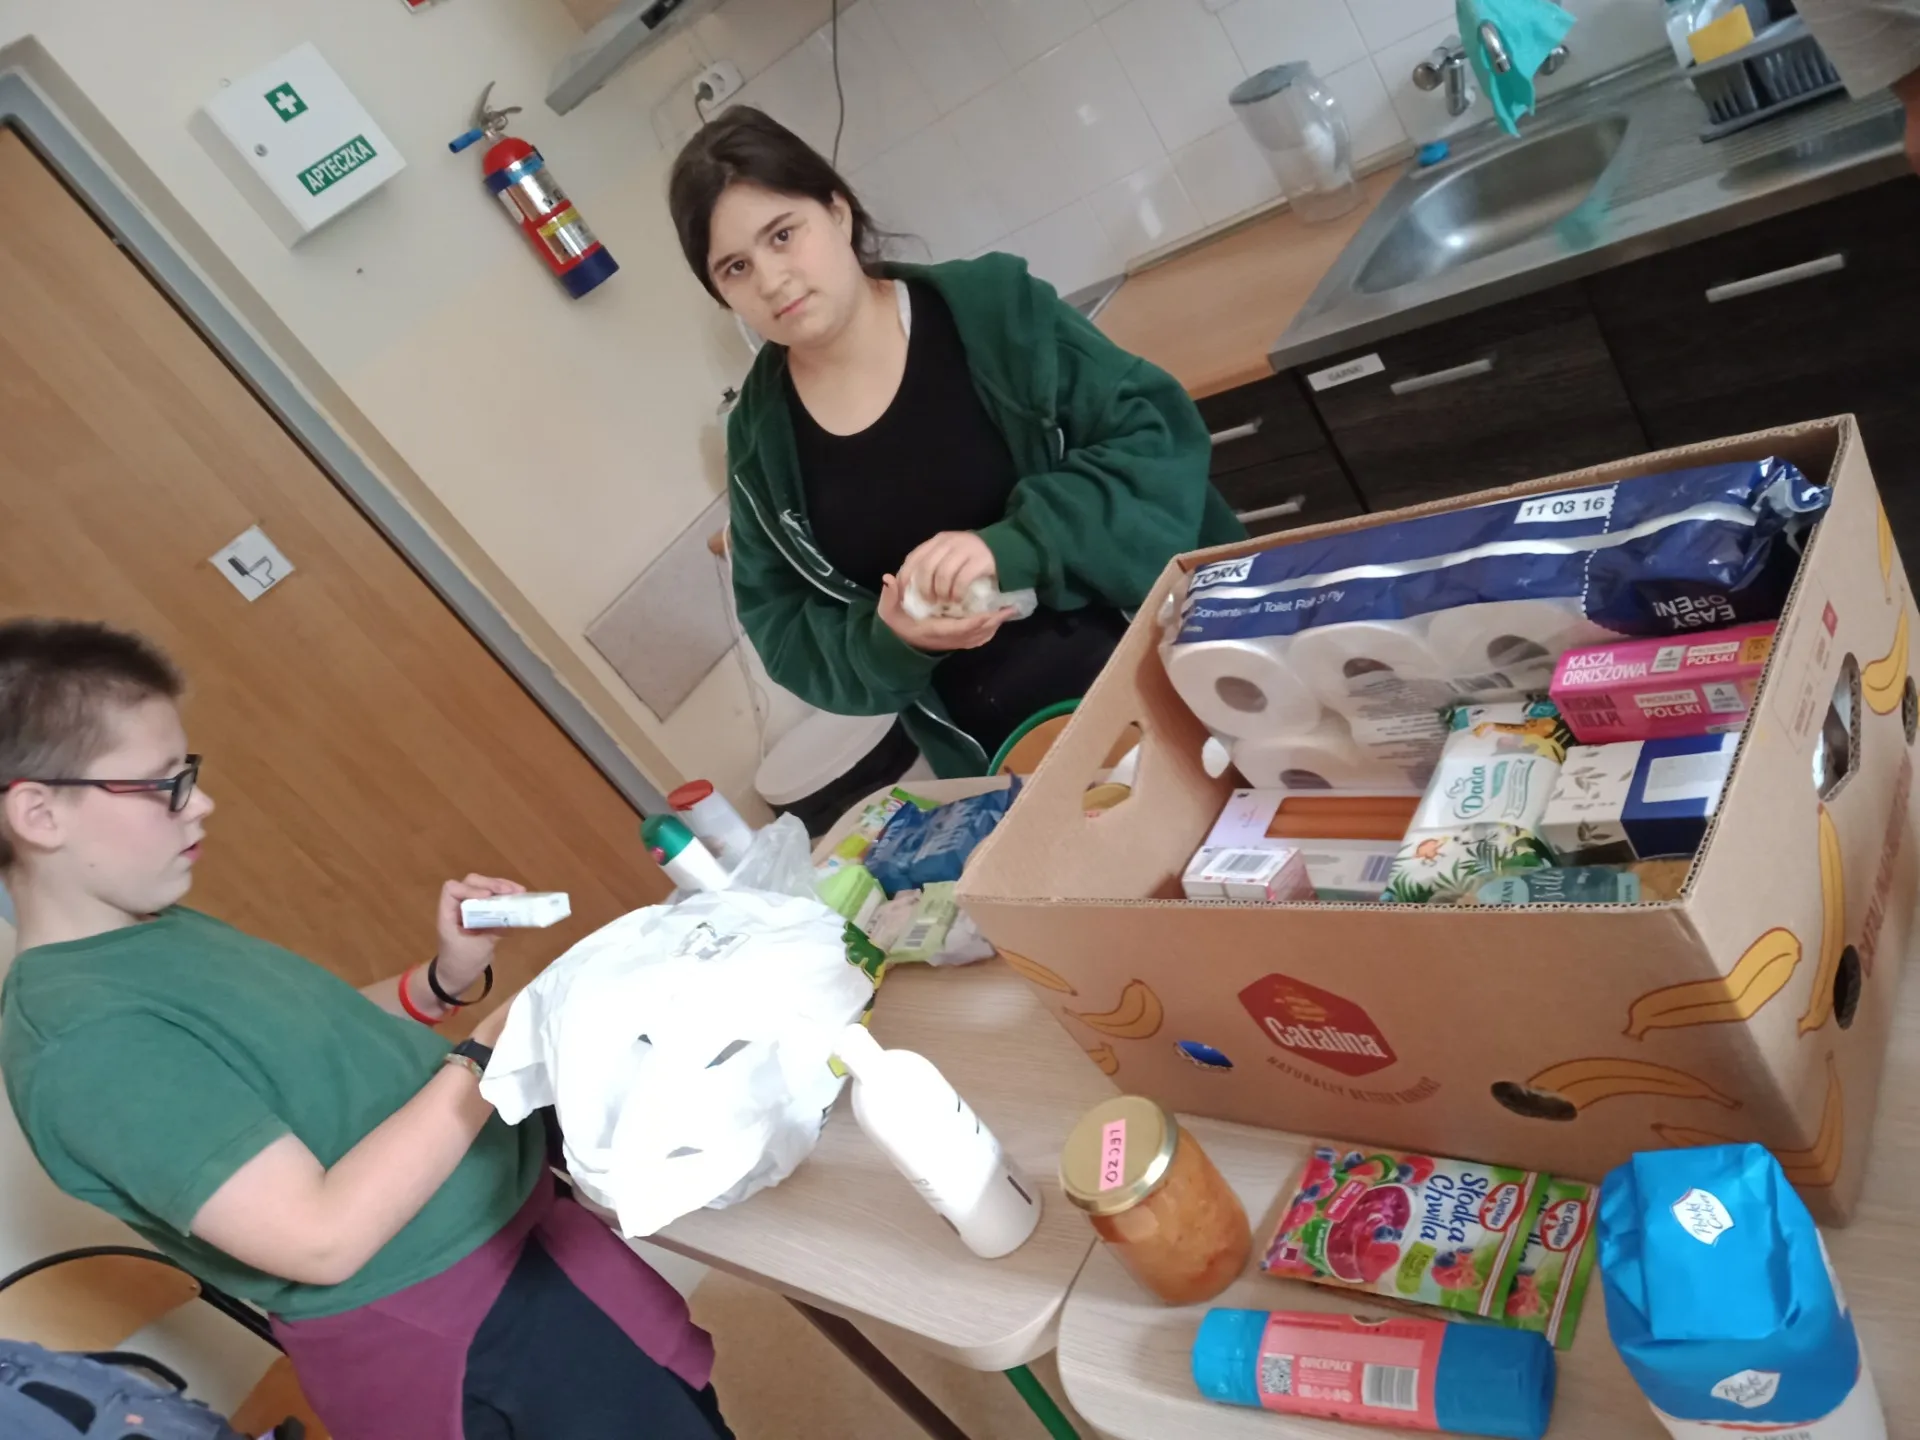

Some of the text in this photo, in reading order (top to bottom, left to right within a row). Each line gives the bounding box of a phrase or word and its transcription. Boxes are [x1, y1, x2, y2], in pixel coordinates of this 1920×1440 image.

[304, 140, 373, 192] APTECZKA
[1524, 496, 1606, 517] 11 03 16
[1195, 562, 1245, 586] TORK
[1264, 600, 1294, 613] Toilet
[1316, 593, 1327, 605] 3
[1654, 594, 1728, 618] OPEN!
[1672, 603, 1736, 630] EASY
[1566, 651, 1615, 670] KASZA
[1685, 652, 1736, 667] POLSKI
[1561, 662, 1649, 687] ORKISZOWA
[1642, 703, 1703, 719] POLSKI
[1461, 765, 1486, 815] Dada
[1264, 1016, 1388, 1058] Catalina
[1266, 1055, 1345, 1097] NATURALLY
[1104, 1128, 1122, 1184] LECZO
[1419, 1174, 1455, 1242] Chwila
[1447, 1172, 1489, 1243] Słodka
[1299, 1355, 1354, 1373] QUICKPACK
